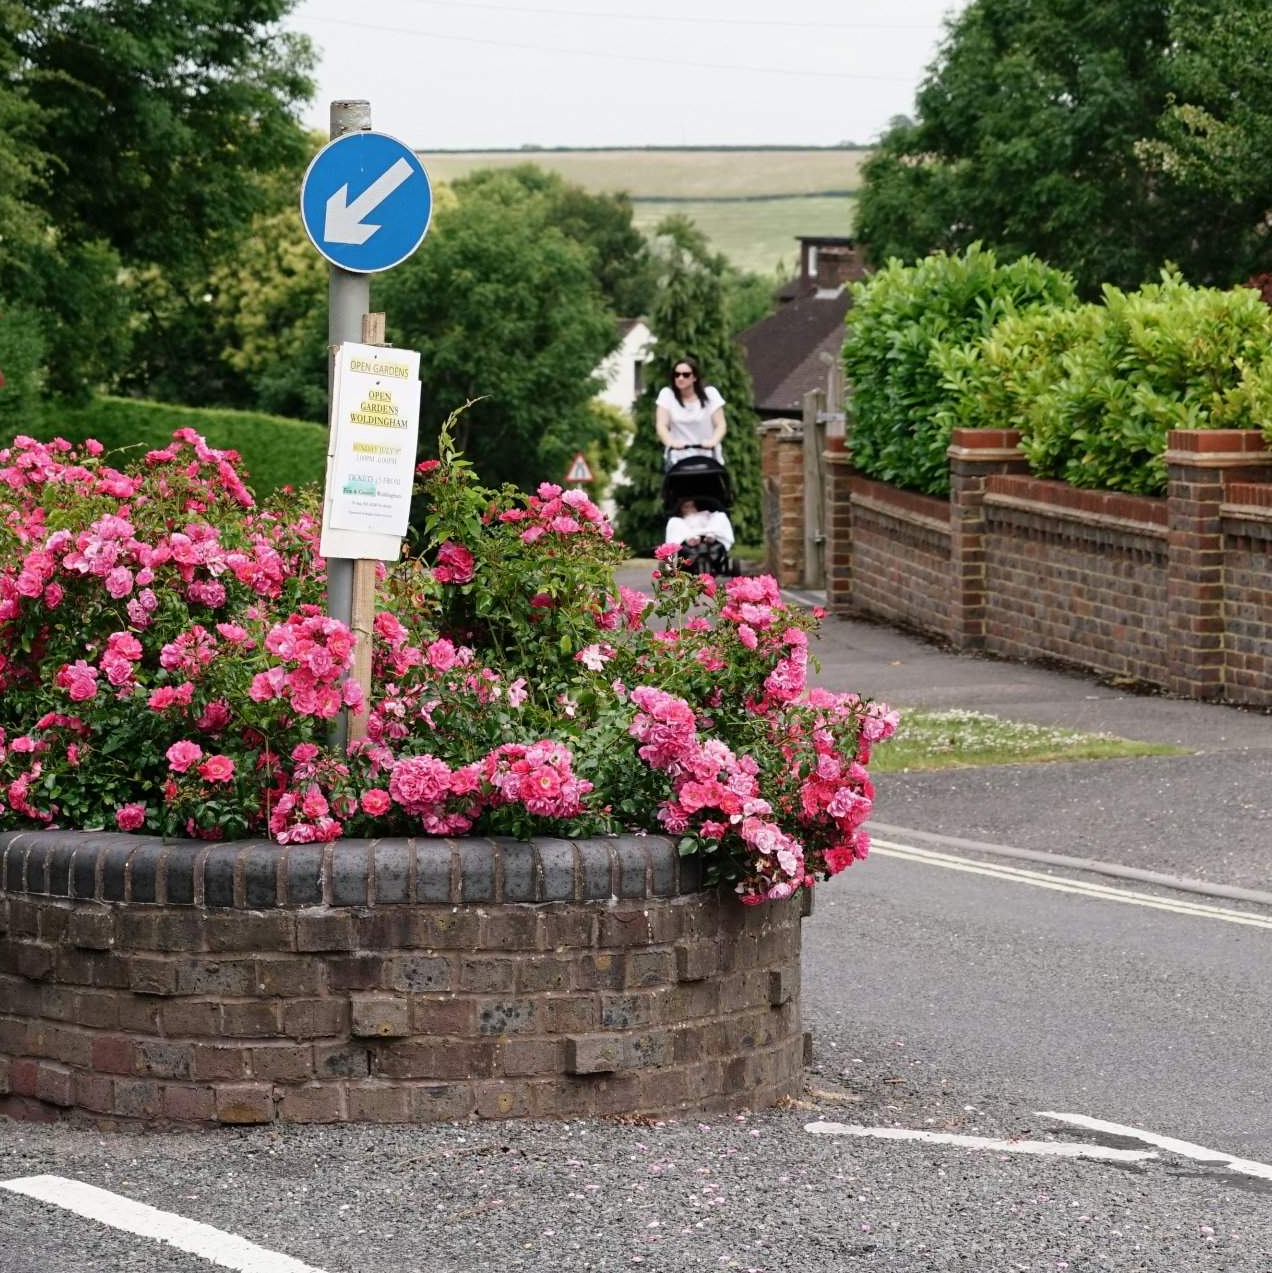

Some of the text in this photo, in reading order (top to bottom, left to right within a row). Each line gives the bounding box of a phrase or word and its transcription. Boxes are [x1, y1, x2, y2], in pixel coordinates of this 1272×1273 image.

[350, 360, 409, 378] OPEN GARDENS
[368, 390, 392, 401] OPEN
[360, 402, 399, 415] GARDENS
[350, 413, 408, 428] WOLDINGHAM
[353, 443, 378, 453] SUNDAY
[348, 474, 374, 483] TICKETS
